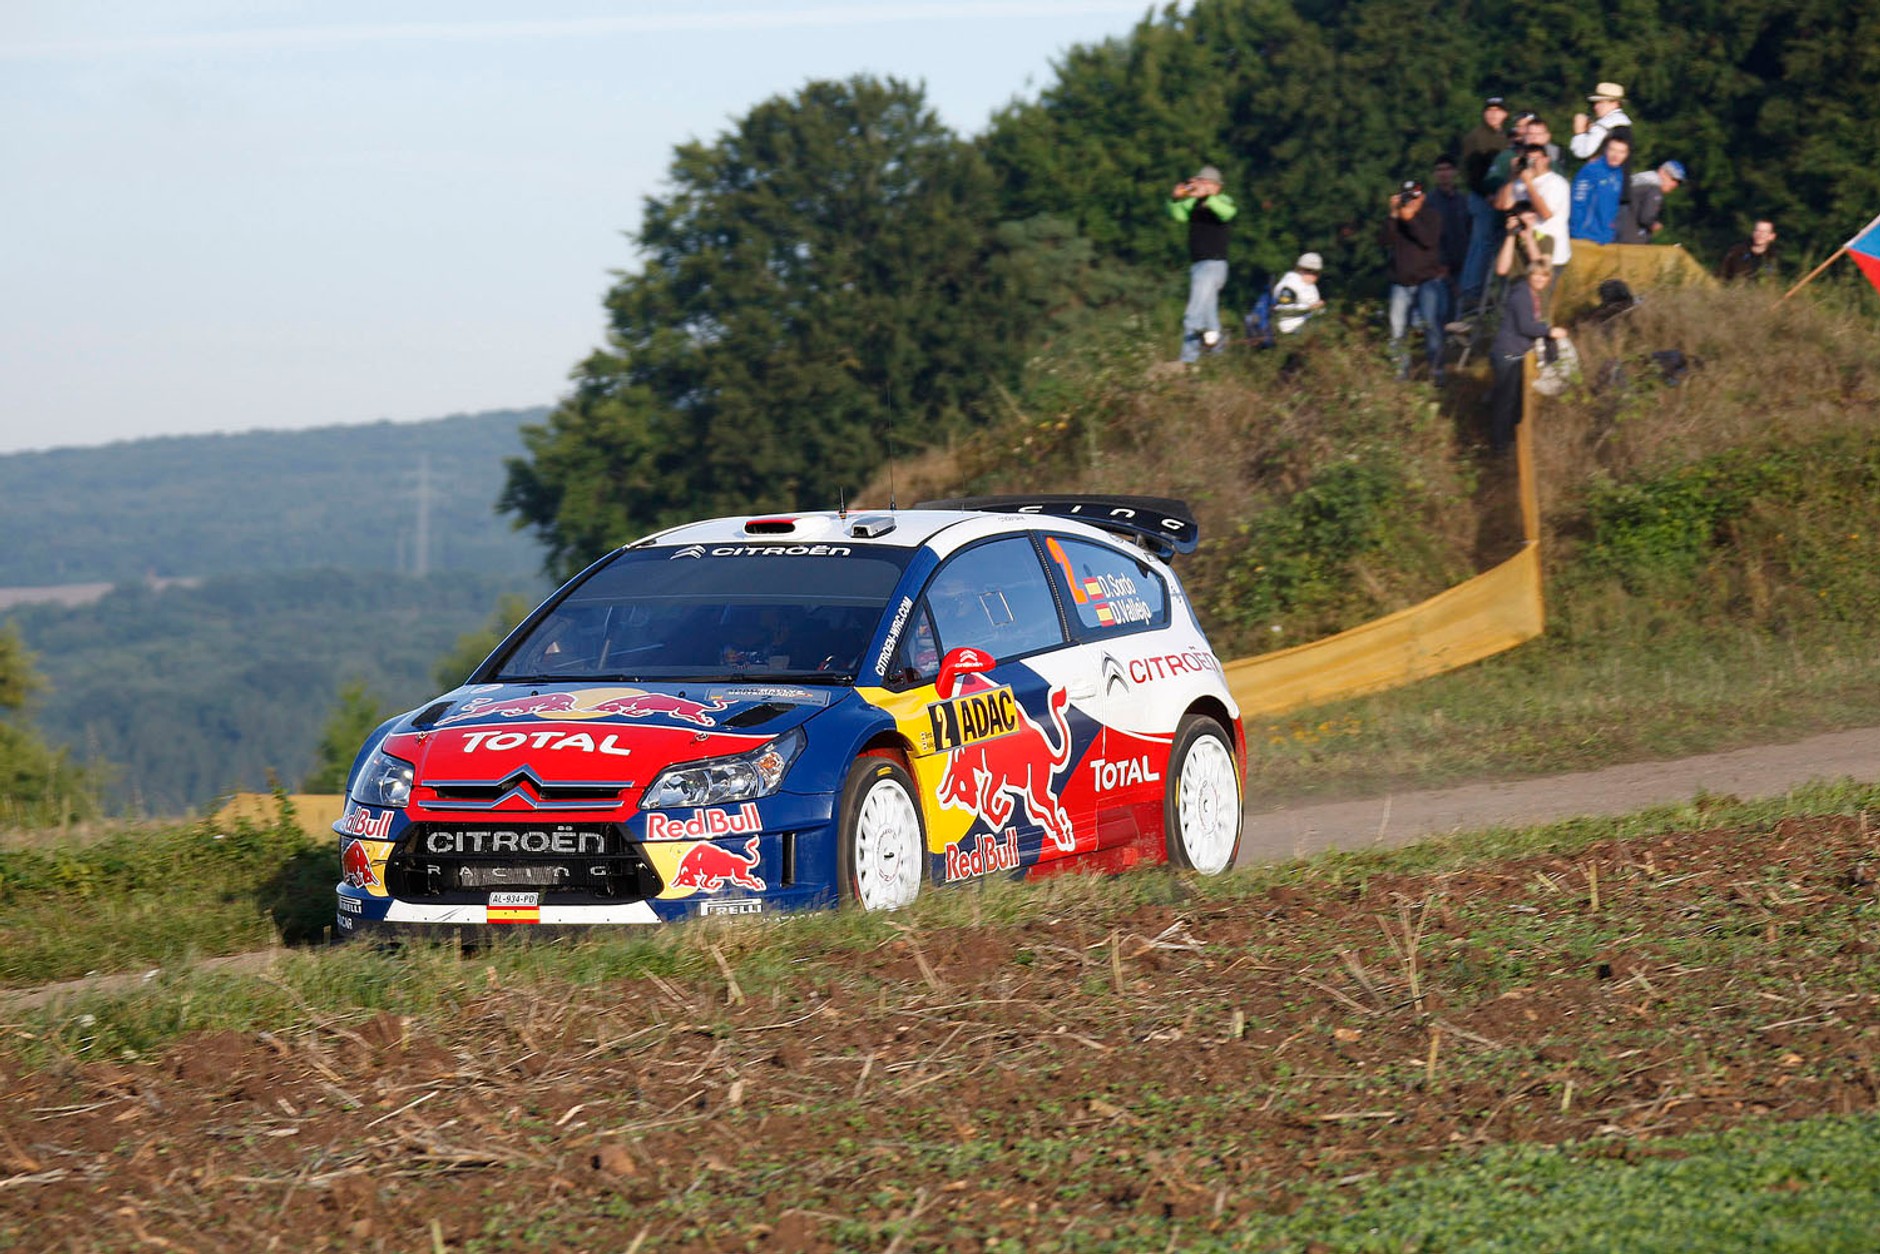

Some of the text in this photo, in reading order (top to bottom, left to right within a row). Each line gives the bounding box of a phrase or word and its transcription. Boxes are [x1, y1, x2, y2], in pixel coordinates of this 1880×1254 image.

[711, 544, 851, 556] CITROËN
[1045, 537, 1089, 604] 2
[1129, 646, 1219, 684] CITROËN
[935, 704, 952, 749] 2
[960, 690, 1015, 742] ADAC
[462, 730, 632, 757] TOTAL
[1090, 755, 1160, 793] TOTAL
[426, 825, 605, 853] CITROËN
[646, 802, 764, 840] Red Bull
[427, 864, 607, 877] RACING
[945, 826, 1020, 883] Red Bull
[701, 898, 763, 916] PIRELLI
